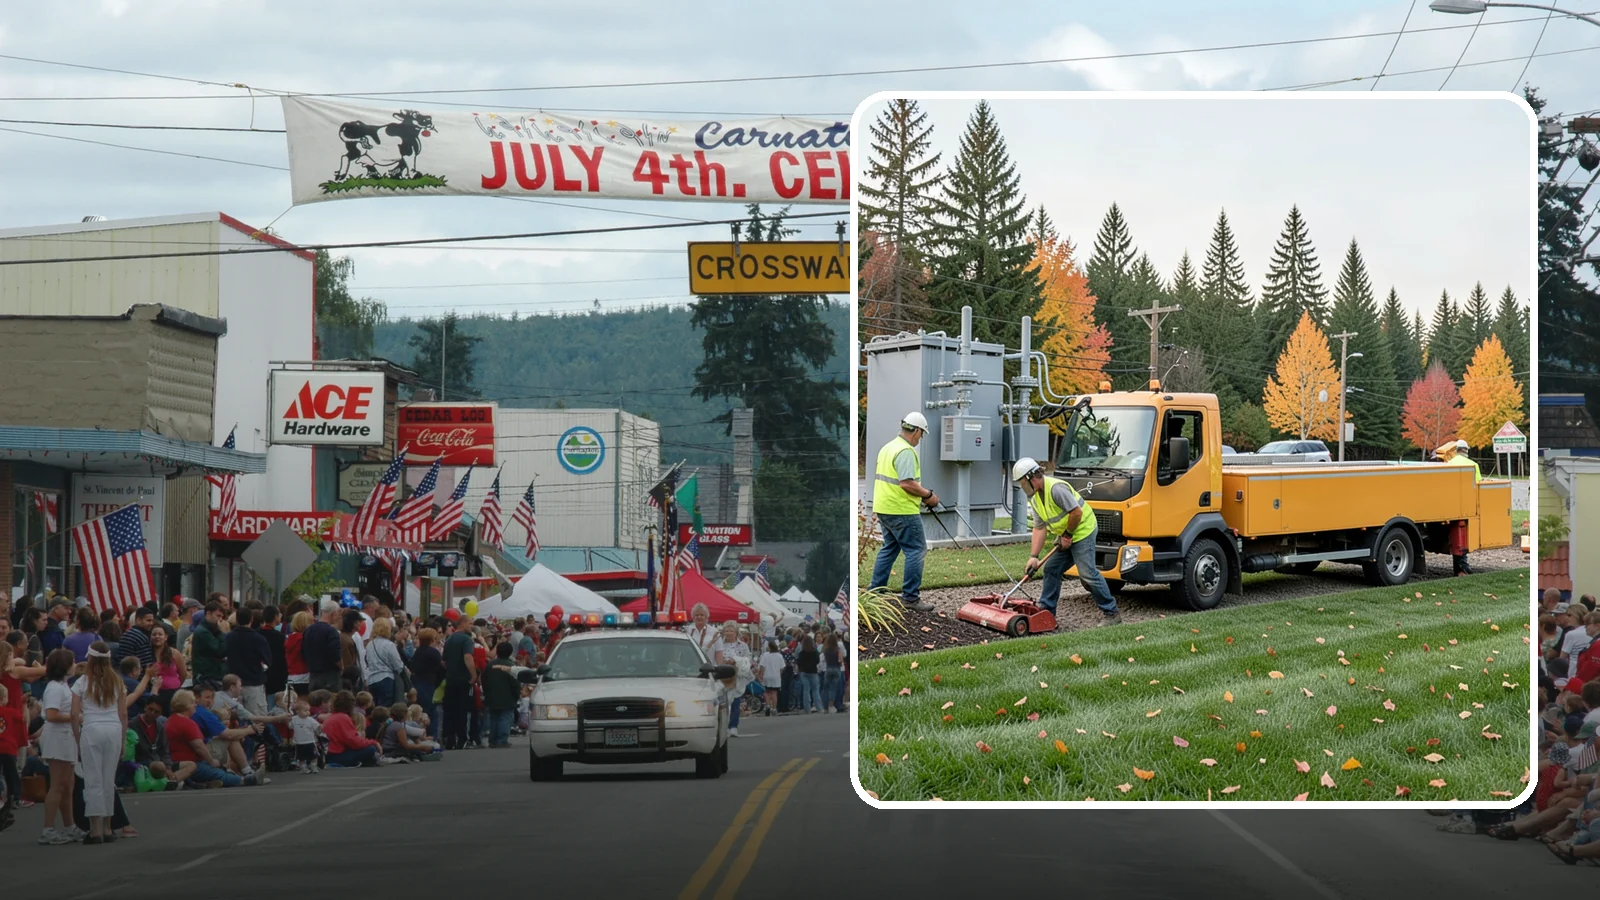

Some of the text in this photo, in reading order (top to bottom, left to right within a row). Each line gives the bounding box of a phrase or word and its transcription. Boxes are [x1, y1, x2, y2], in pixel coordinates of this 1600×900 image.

[481, 141, 605, 192] JULY
[633, 150, 746, 198] 4th.
[696, 254, 850, 280] CROSSWA
[283, 380, 373, 420] ACE
[405, 409, 452, 421] CEDAR
[283, 421, 371, 436] Hardware
[416, 428, 477, 447] Coca-Cola
[353, 467, 386, 480] Simpl
[83, 485, 155, 495] St. Vincent de Paul
[688, 526, 741, 535] CRNATION
[699, 535, 731, 543] GLASS
